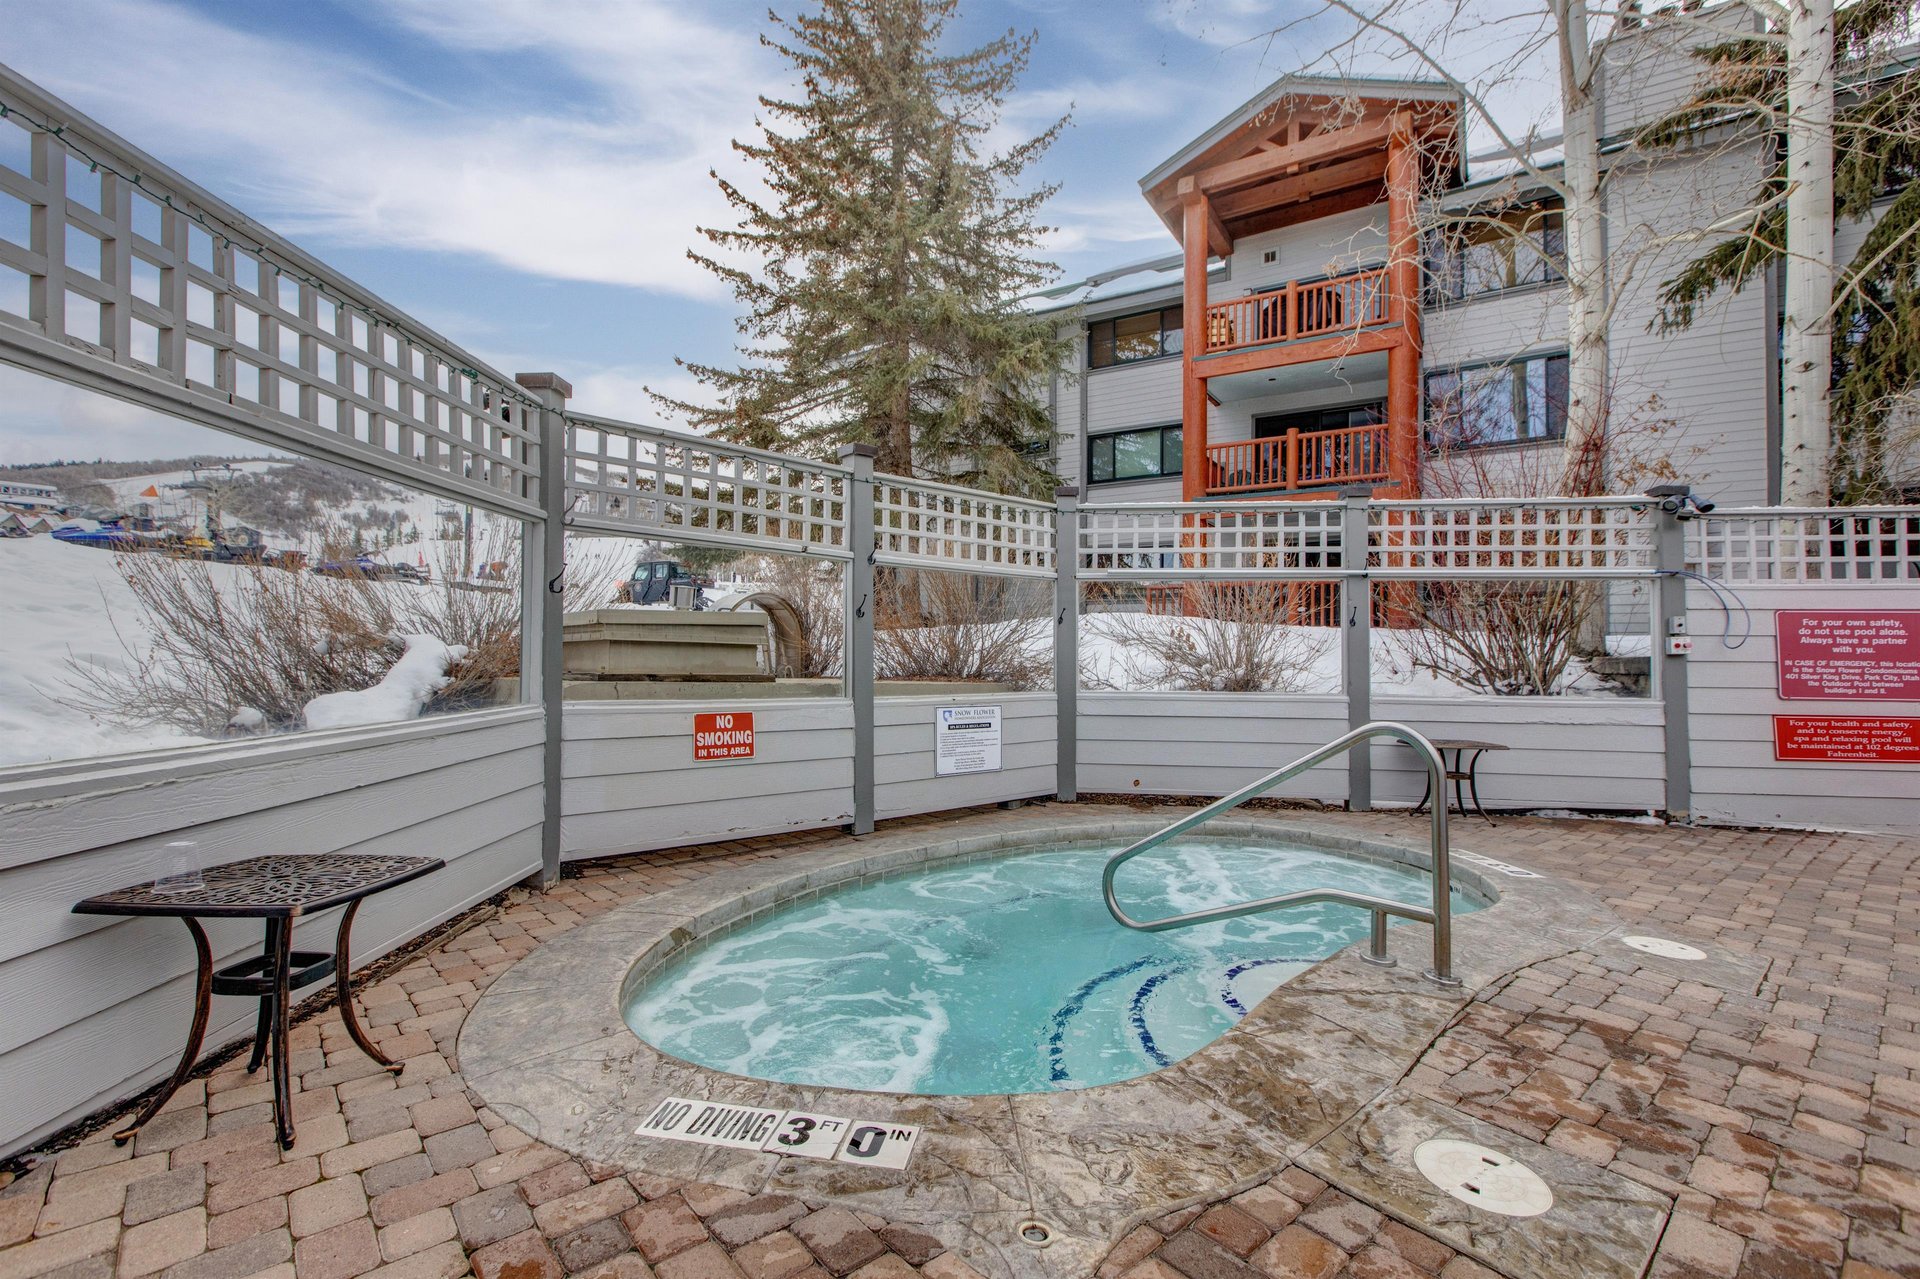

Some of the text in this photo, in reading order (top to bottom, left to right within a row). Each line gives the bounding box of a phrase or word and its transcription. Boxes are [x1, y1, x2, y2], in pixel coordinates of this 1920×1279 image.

[1870, 619, 1902, 628] safety,
[716, 715, 733, 728] NO
[696, 730, 752, 746] SMOKING
[730, 746, 750, 755] AREA
[644, 1101, 777, 1143] NO DIVING
[777, 1117, 817, 1146] 3
[819, 1120, 844, 1132] FT
[890, 1129, 912, 1141] IN
